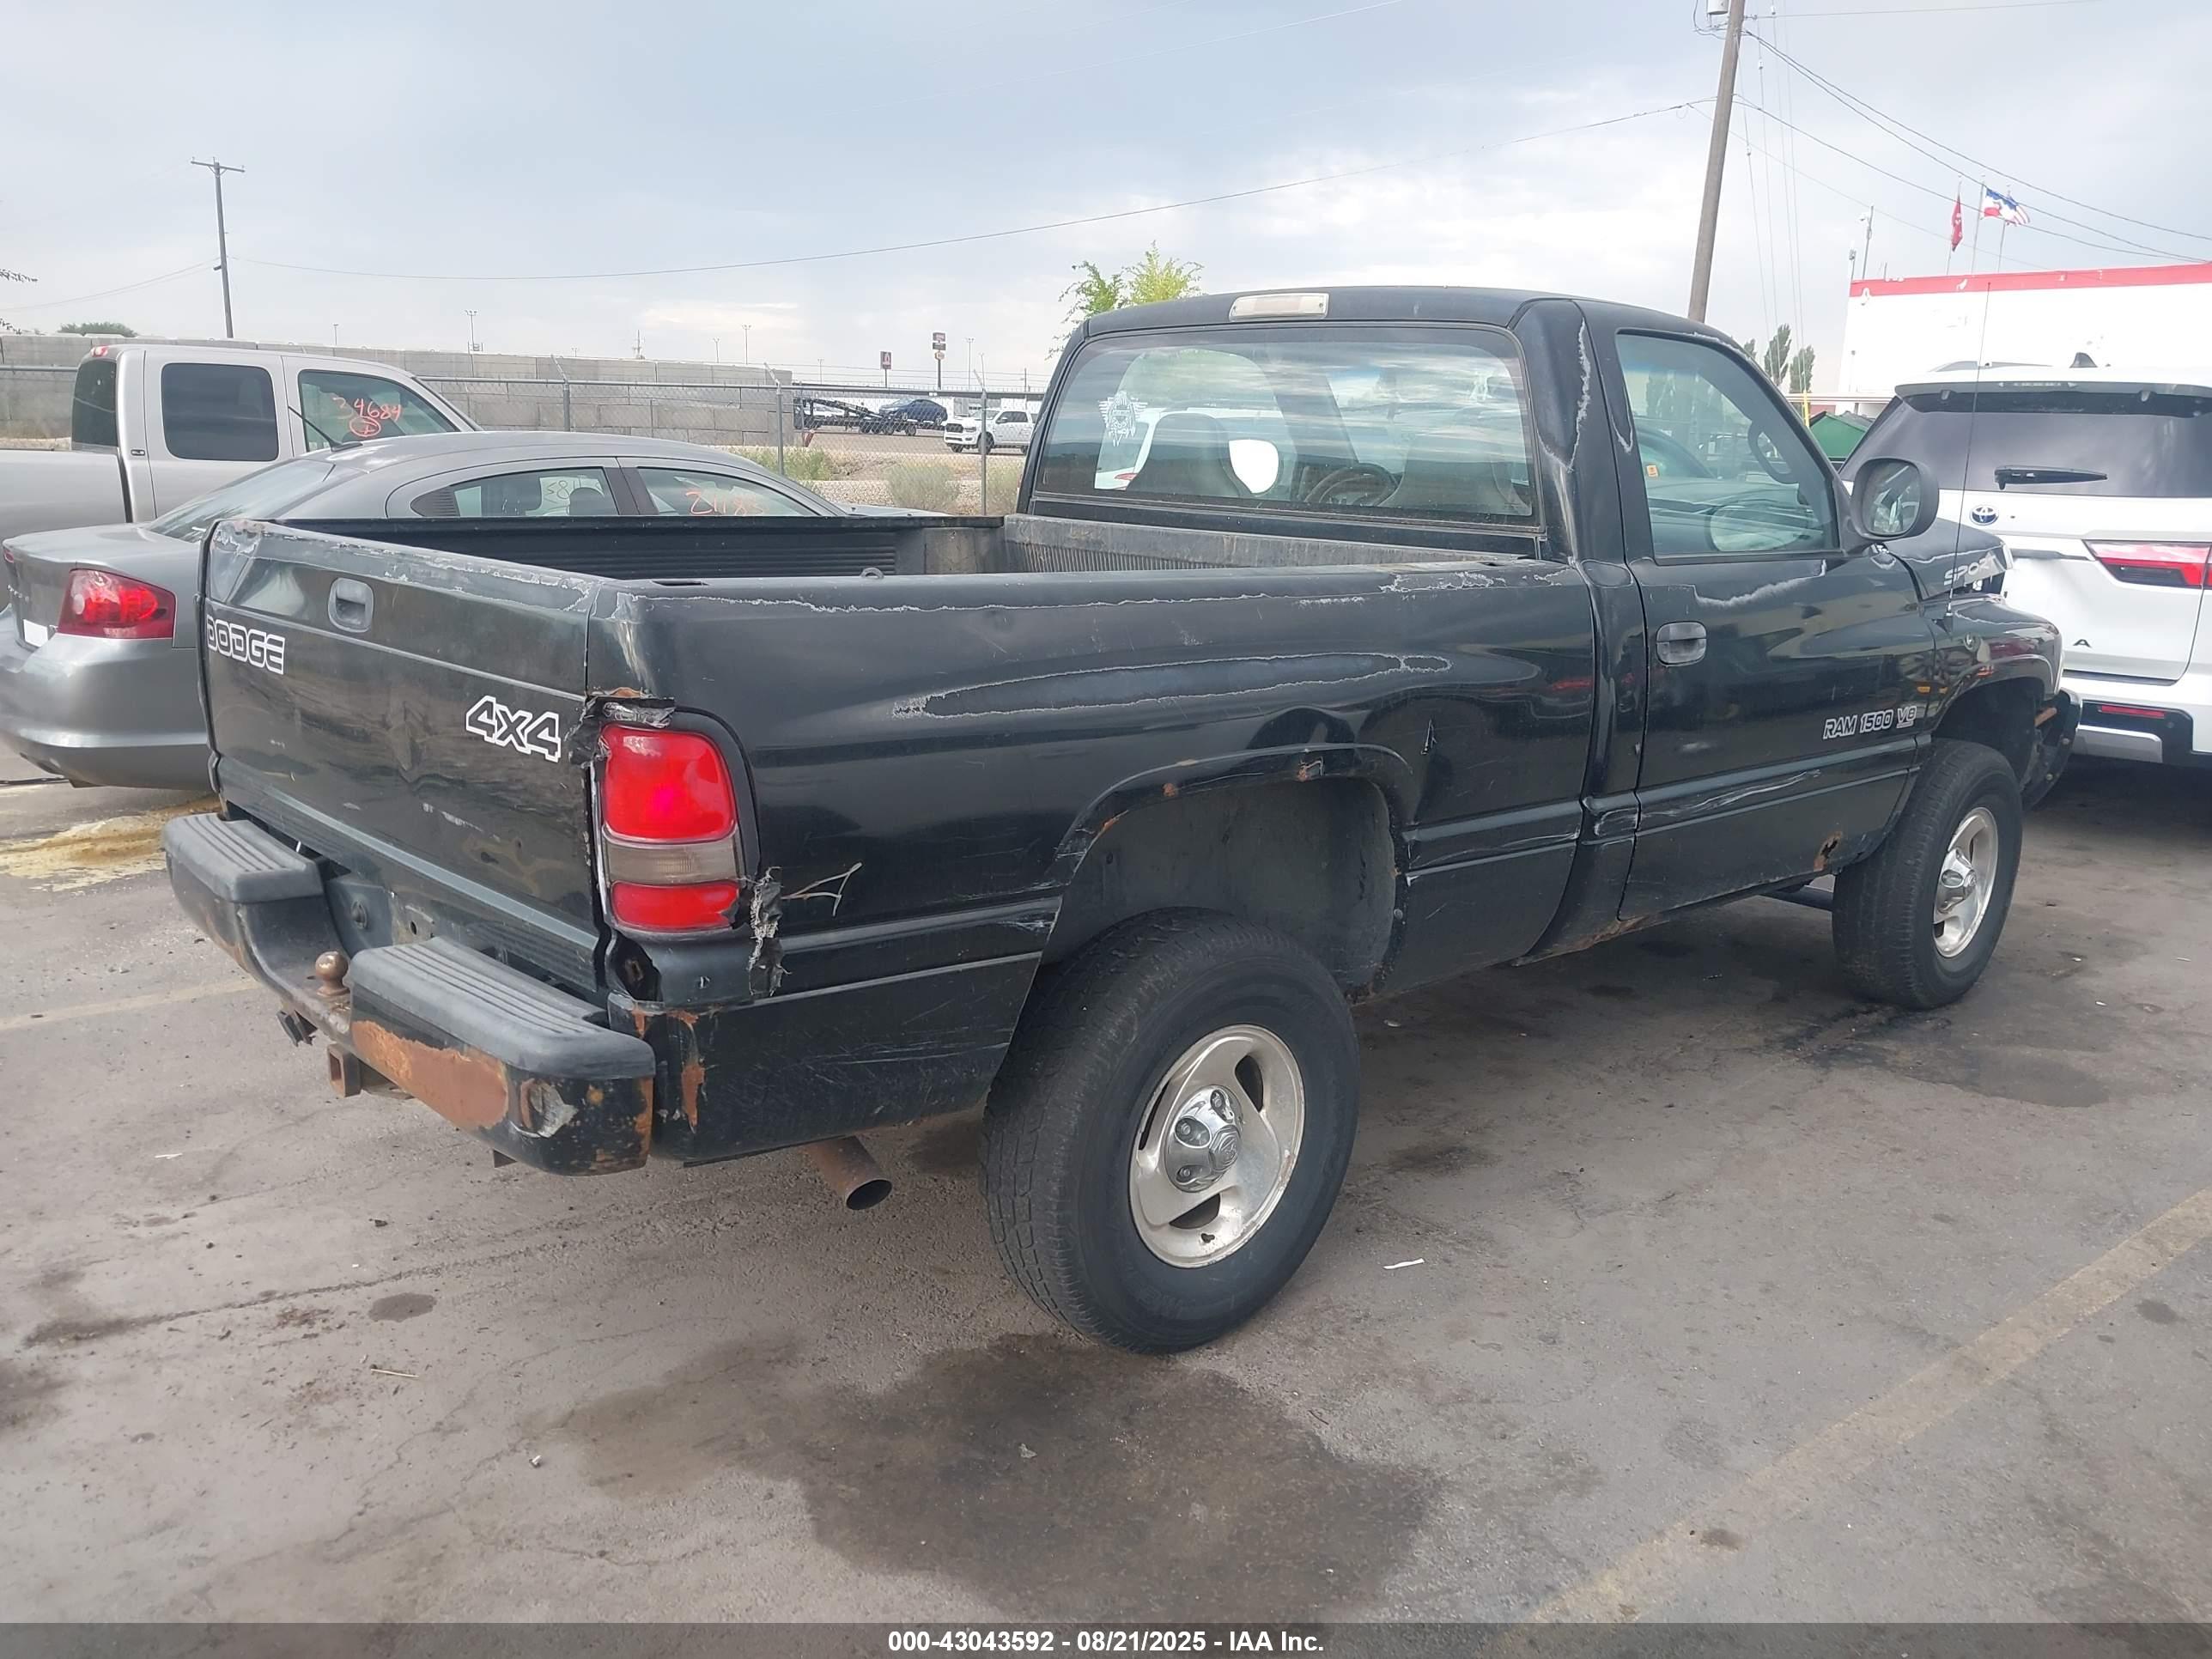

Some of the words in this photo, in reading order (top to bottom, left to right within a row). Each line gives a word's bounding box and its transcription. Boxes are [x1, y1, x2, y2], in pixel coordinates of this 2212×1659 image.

[207, 614, 286, 676] DODGE
[1822, 714, 1857, 739] RAM
[1860, 709, 1893, 732] 1500
[1897, 706, 1917, 724] V8
